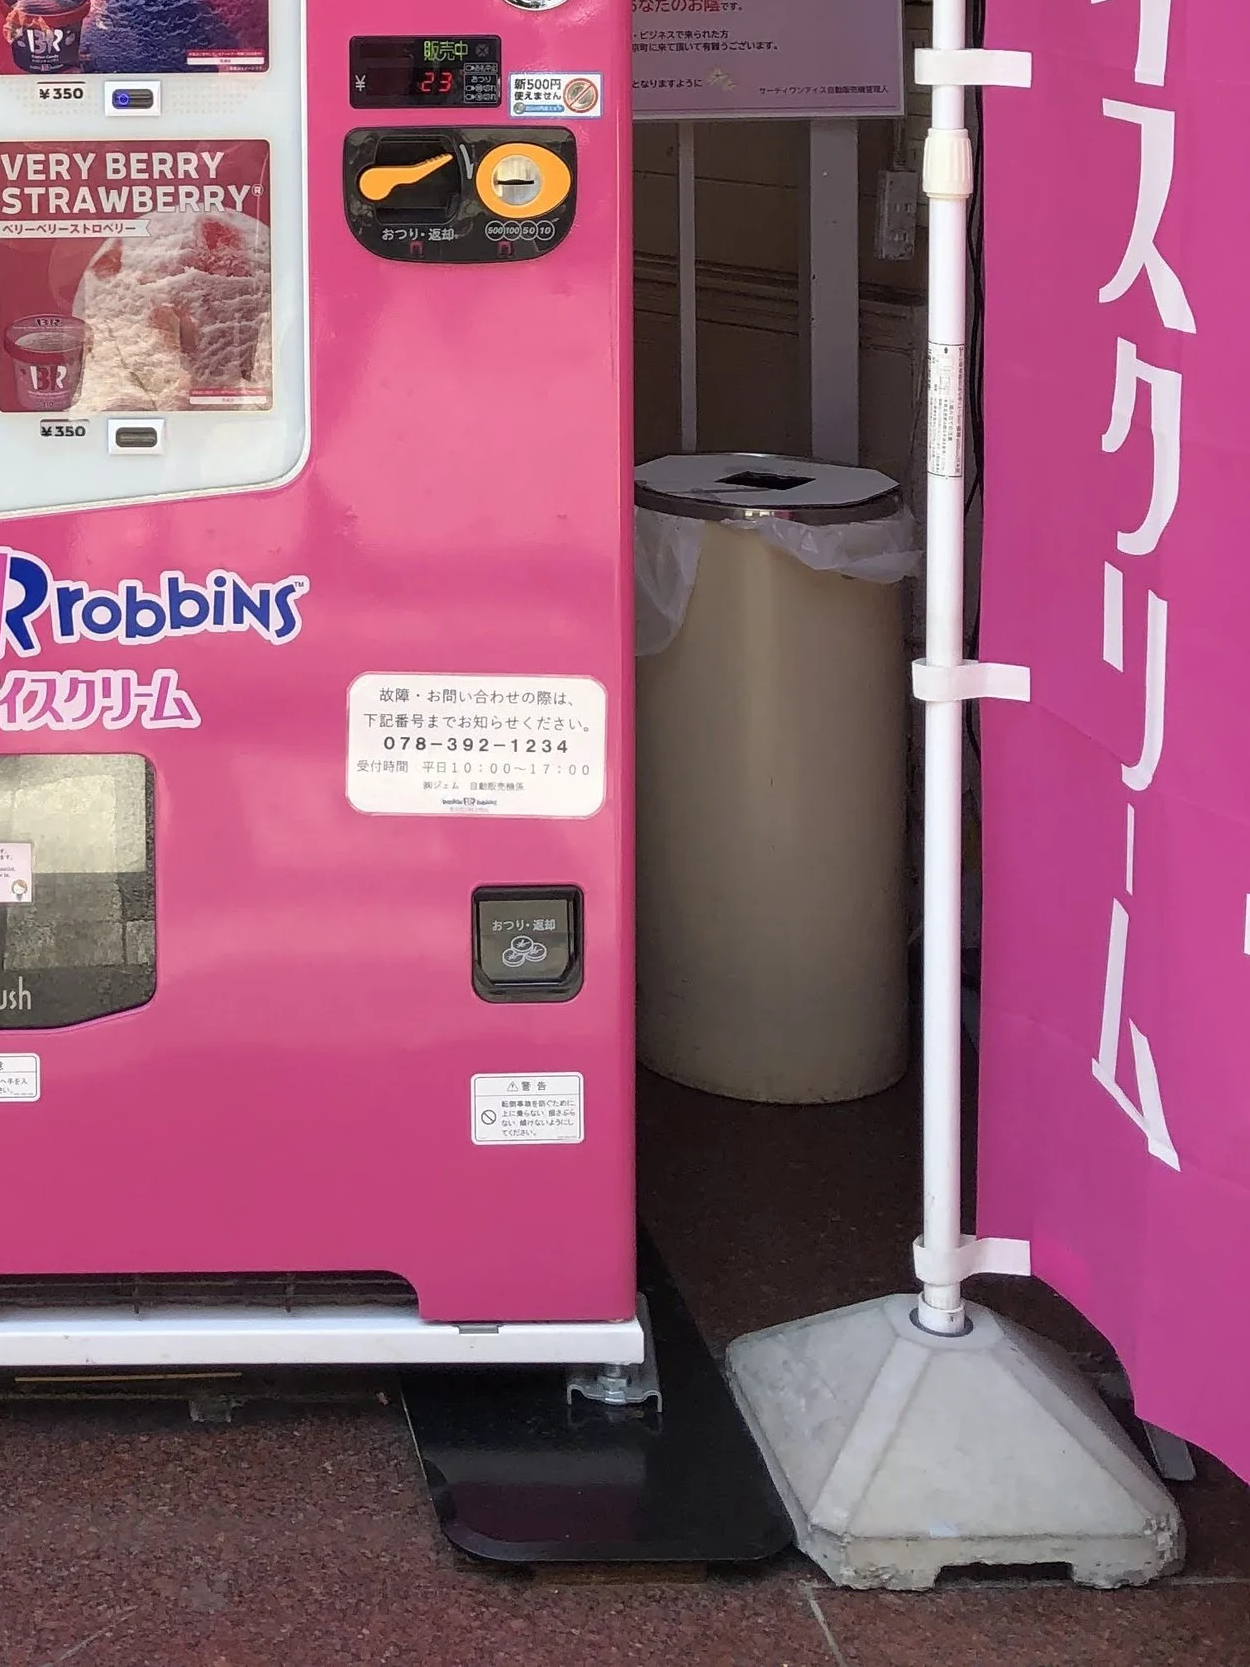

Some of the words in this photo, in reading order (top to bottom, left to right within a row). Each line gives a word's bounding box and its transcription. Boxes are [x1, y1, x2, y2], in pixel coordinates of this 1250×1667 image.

[424, 41, 468, 61] 販売中
[514, 79, 562, 90] 新500円
[39, 87, 84, 100] ¥350
[514, 92, 562, 100] 使えません
[1, 153, 95, 181] VERY
[105, 152, 224, 180] BERRY
[2, 222, 136, 235] ベリーベリーストロベリー
[382, 228, 454, 241] おつり・返却
[487, 225, 504, 235] 500
[505, 225, 520, 235] 100
[522, 225, 535, 235] 50
[540, 225, 551, 235] 10
[41, 425, 86, 437] ¥350
[379, 687, 573, 706] 故障・お問い合わせの際は、
[364, 713, 589, 732] 下記番号までお知らせください。
[356, 760, 409, 773] 受付時間
[492, 919, 555, 932] おつり・返却
